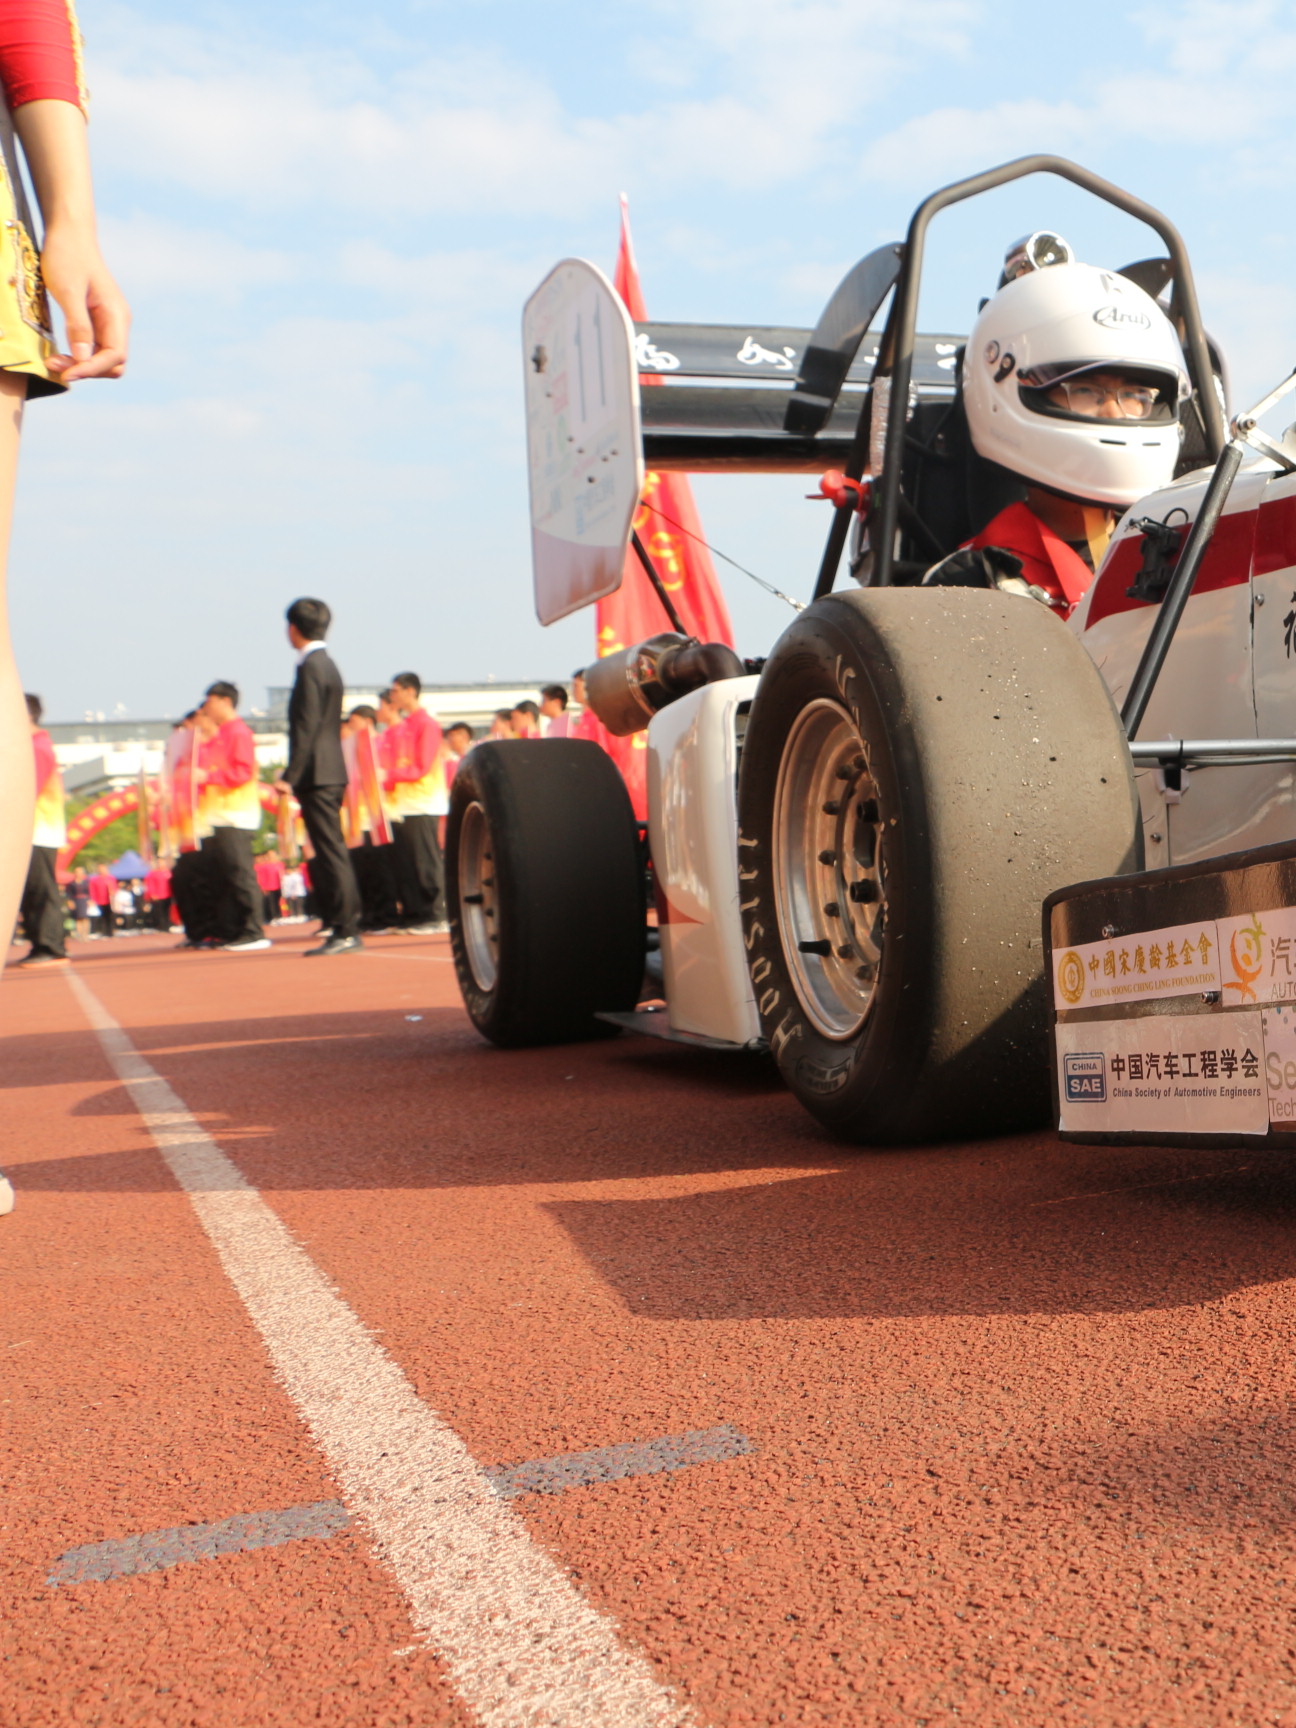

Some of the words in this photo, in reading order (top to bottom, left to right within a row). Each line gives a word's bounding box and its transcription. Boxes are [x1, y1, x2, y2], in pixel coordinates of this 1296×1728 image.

[1090, 985, 1110, 998] CHINA
[1111, 984, 1132, 995] SOONG
[1133, 981, 1154, 993] CHING
[1155, 978, 1170, 990] LING
[1171, 973, 1216, 988] FOUNDATION
[1071, 1062, 1098, 1071] CHINA
[1111, 1047, 1259, 1081] 中国汽车工程学会
[1070, 1078, 1102, 1093] SAE
[1112, 1087, 1132, 1098] China
[1135, 1086, 1161, 1100] Society
[1163, 1086, 1172, 1098] of
[1174, 1086, 1217, 1098] Automotive
[1219, 1086, 1261, 1100] Engineers
